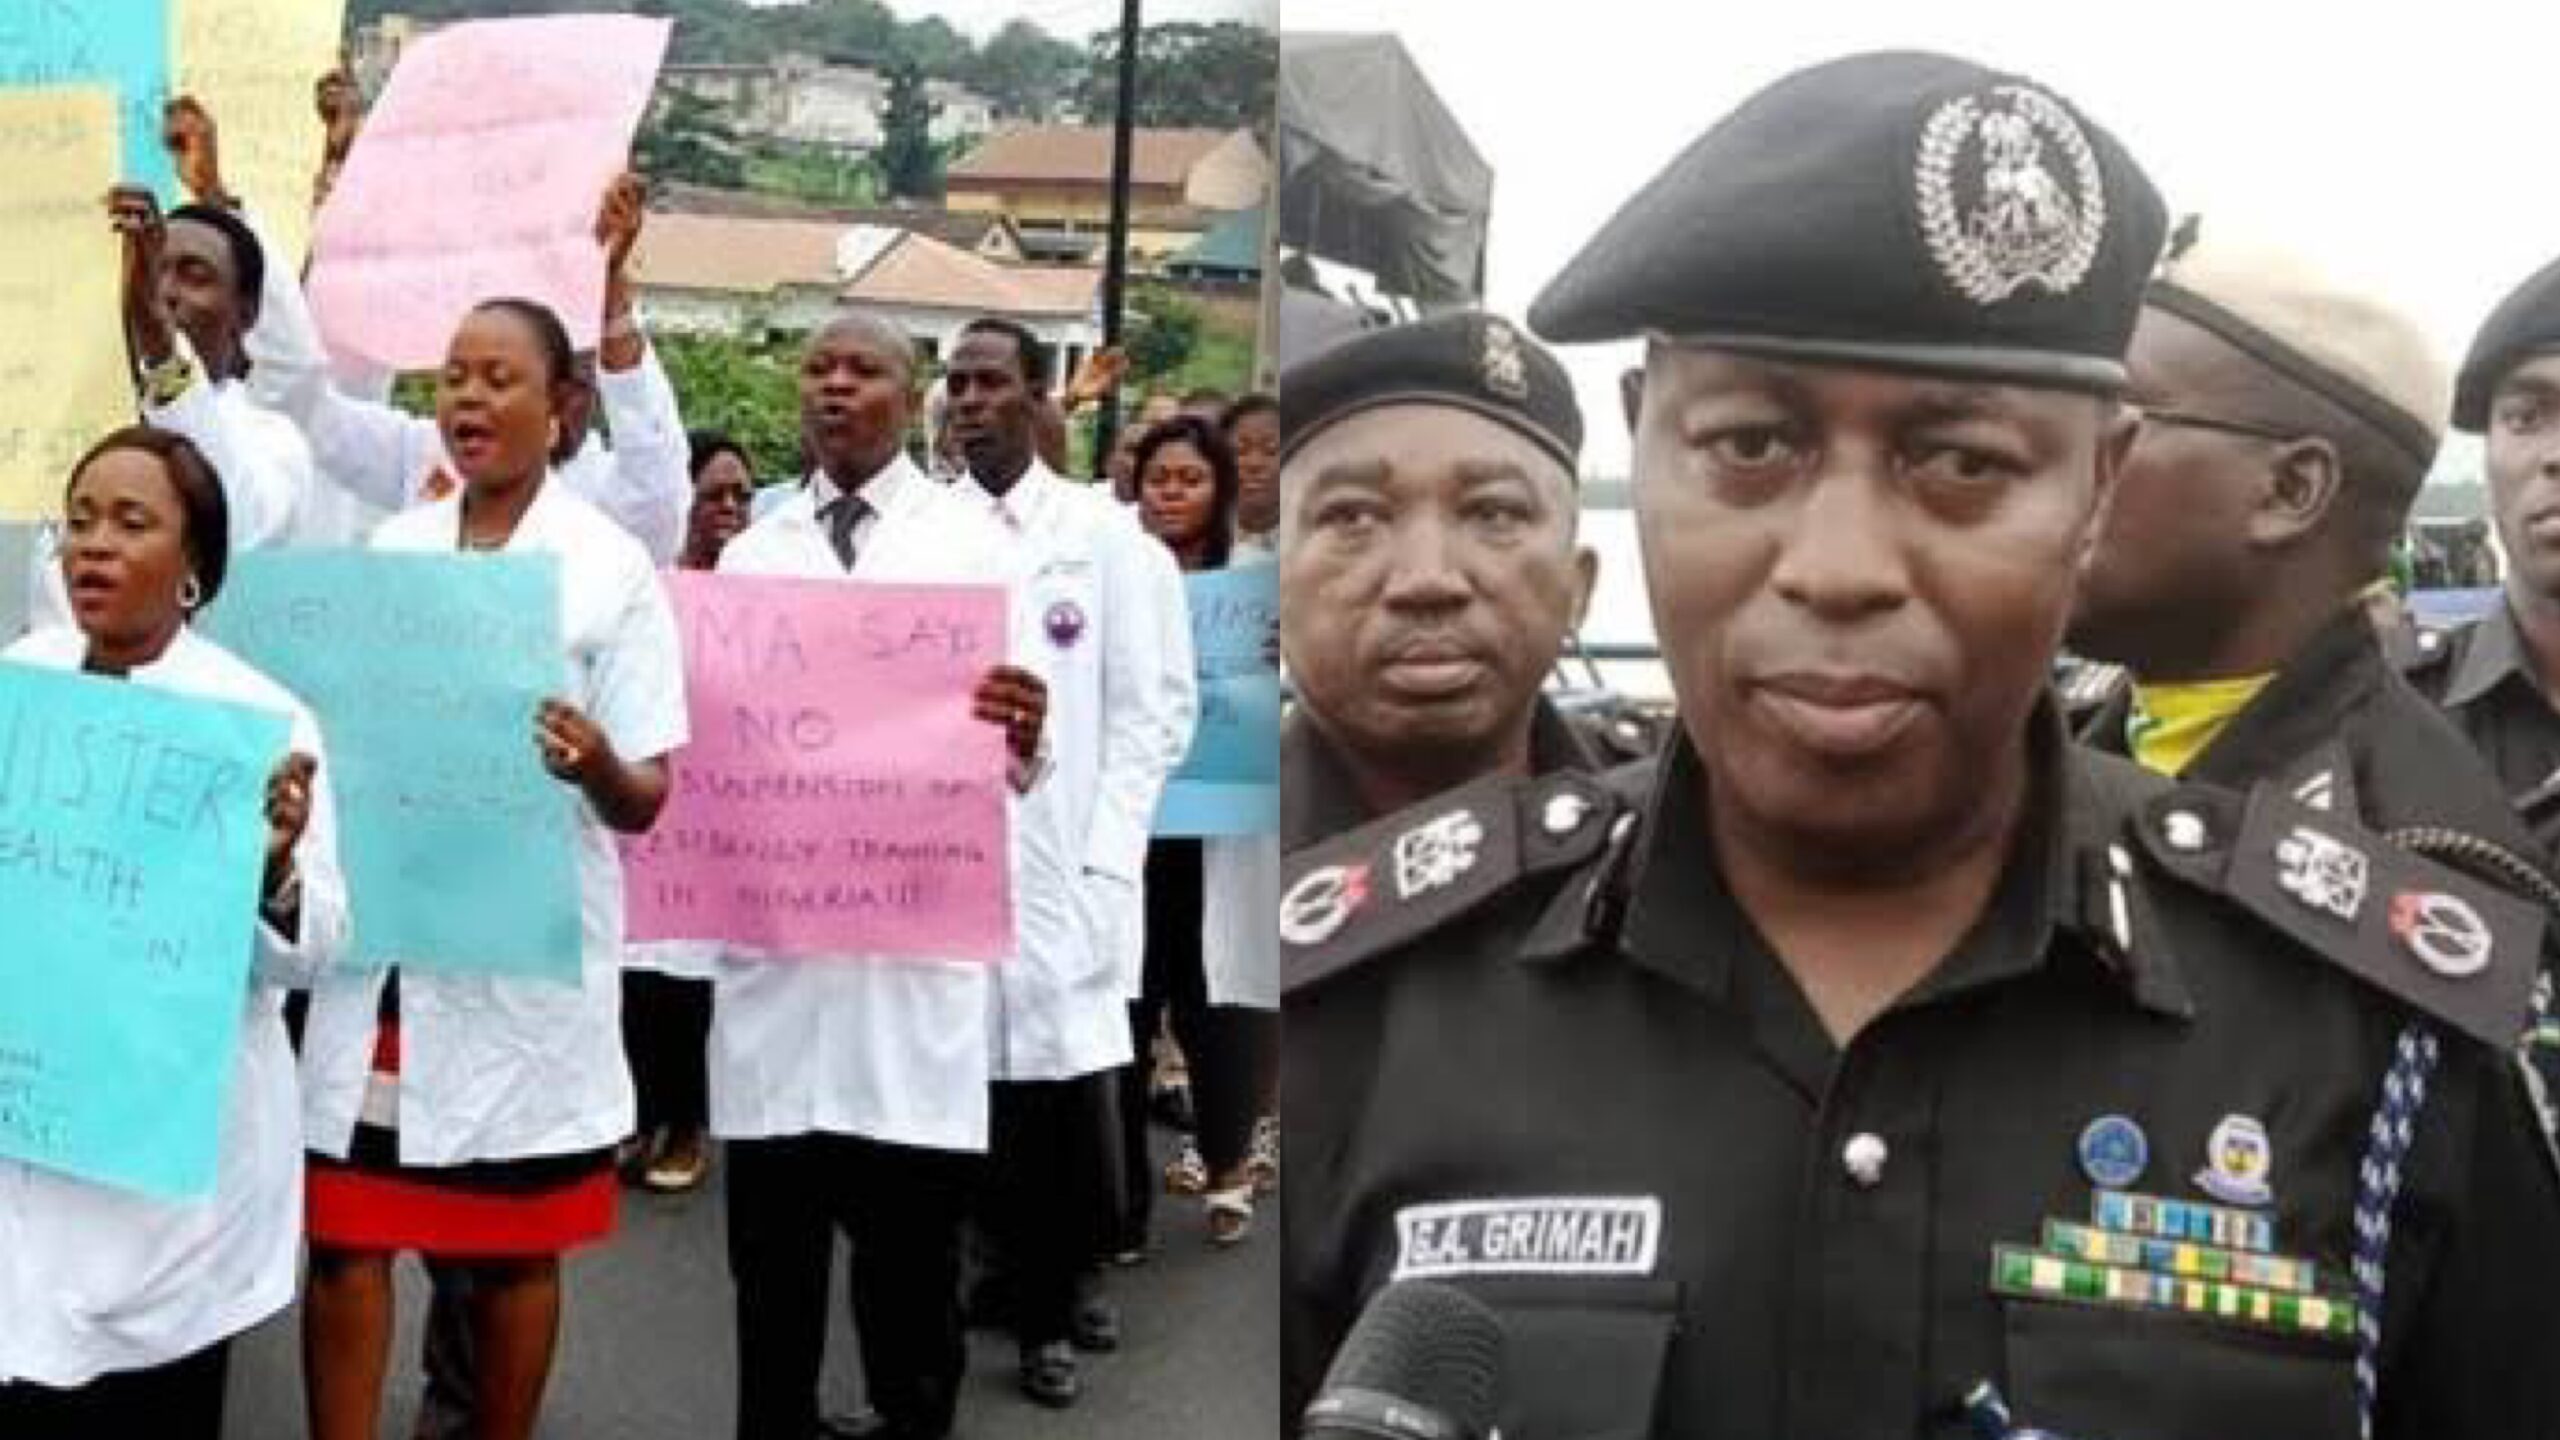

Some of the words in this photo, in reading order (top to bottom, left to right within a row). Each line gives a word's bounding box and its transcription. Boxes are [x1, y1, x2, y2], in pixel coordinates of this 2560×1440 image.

[732, 702, 837, 752] NO
[657, 879, 696, 913] IN
[1483, 1210, 1639, 1263] GRIMAH
